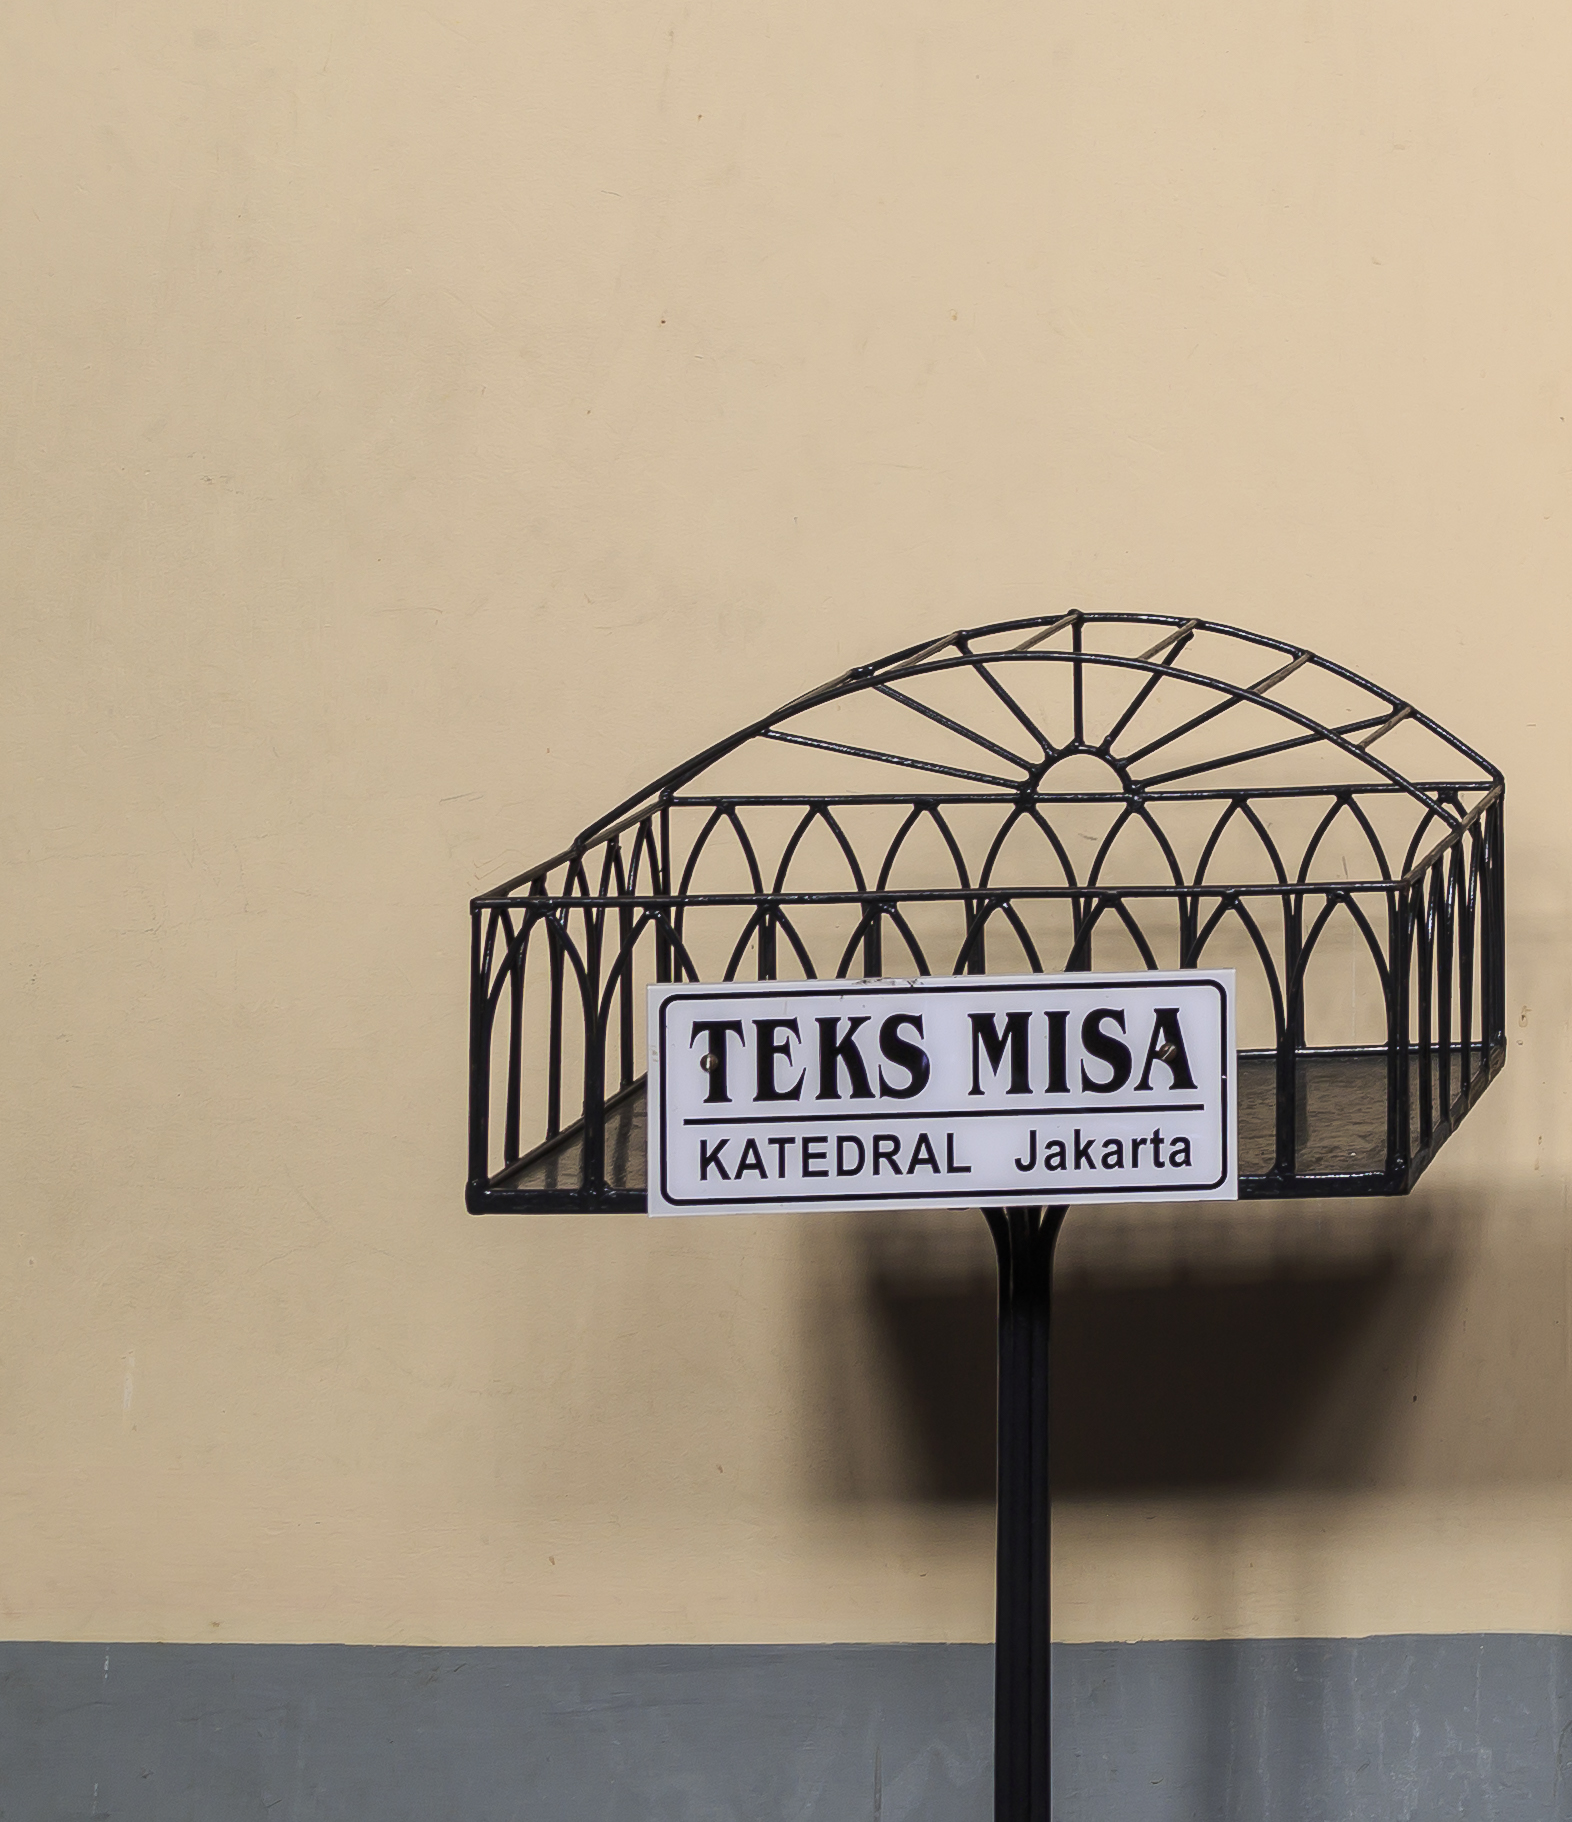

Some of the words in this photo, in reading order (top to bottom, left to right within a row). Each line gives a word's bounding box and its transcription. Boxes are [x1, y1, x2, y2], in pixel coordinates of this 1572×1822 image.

[688, 1013, 932, 1104] TEKS
[967, 1007, 1199, 1096] MISA
[699, 1131, 973, 1181] KATEDRAL
[1014, 1127, 1193, 1174] Jakarta
